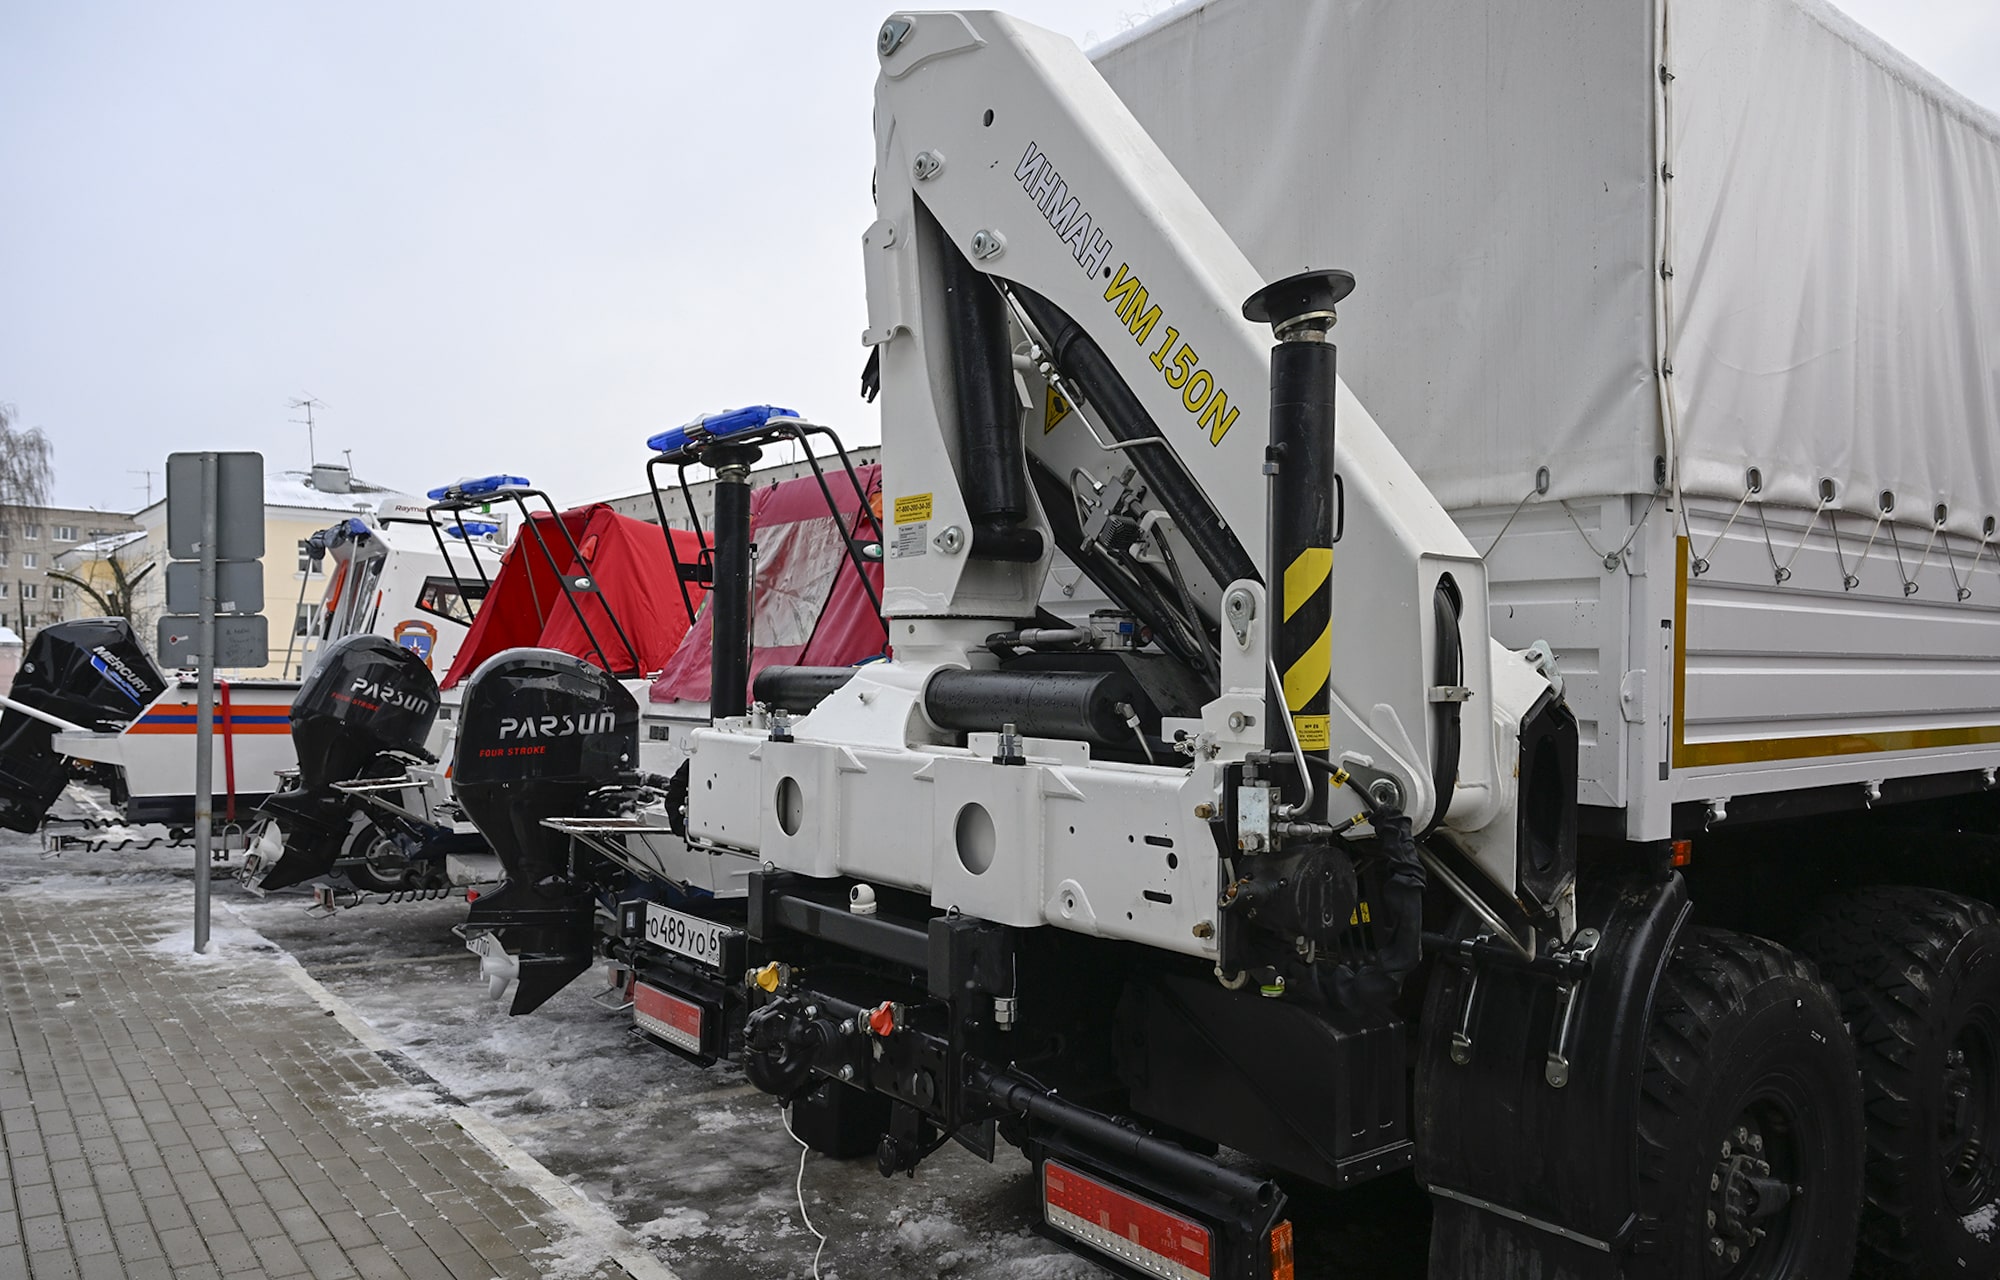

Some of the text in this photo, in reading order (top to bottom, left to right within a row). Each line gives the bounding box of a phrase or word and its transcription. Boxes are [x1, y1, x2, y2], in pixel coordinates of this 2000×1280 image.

[1014, 141, 1240, 447] ИНМАН ИМ 150N
[92, 645, 152, 693] MERCURY
[330, 692, 381, 712] FOUR STROKE
[350, 677, 429, 715] PARSUN
[499, 712, 616, 740] PARSUN
[479, 746, 546, 757] FOUR STROKE
